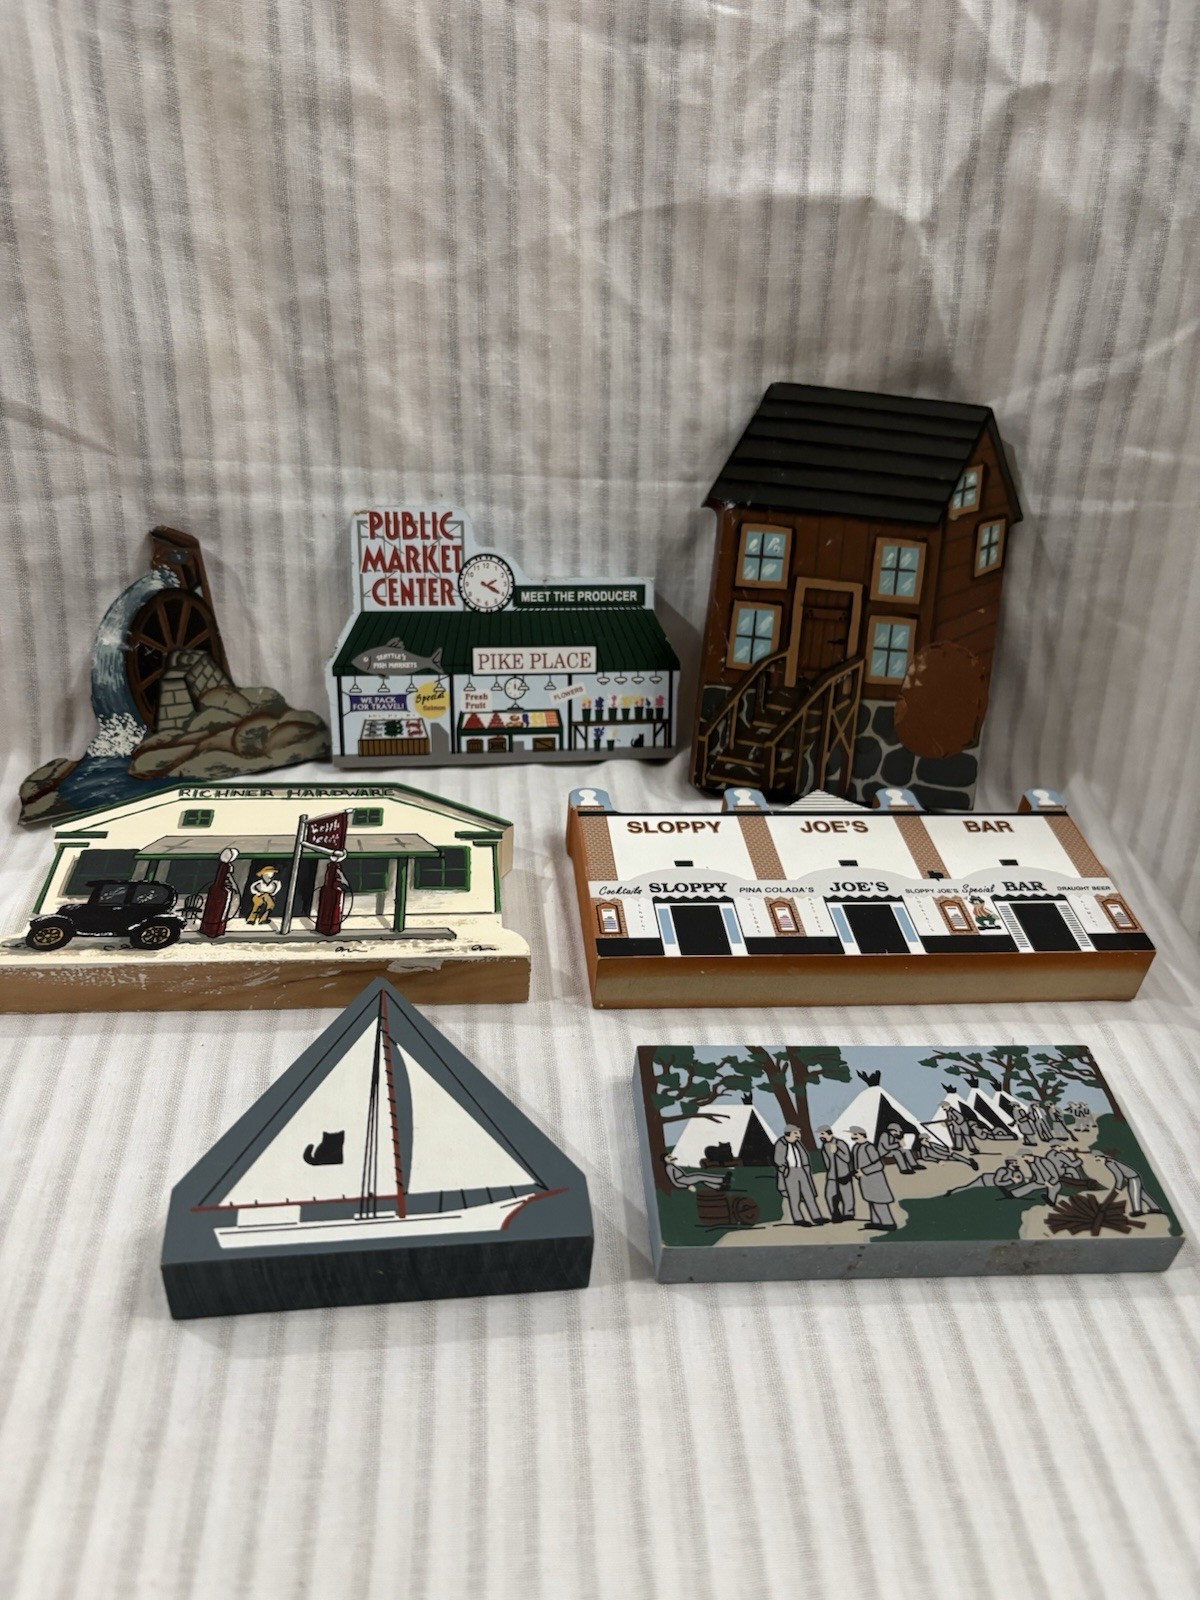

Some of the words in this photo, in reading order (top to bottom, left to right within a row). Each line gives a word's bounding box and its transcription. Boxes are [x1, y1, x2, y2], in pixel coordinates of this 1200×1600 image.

[368, 511, 453, 541] PUBLIC
[361, 544, 462, 573] MARKET
[371, 577, 456, 607] CENTER
[521, 591, 551, 602] MEET
[553, 591, 575, 602] THE
[577, 590, 638, 602] PRODUCER
[373, 662, 388, 670] FISH
[388, 661, 418, 669] MARKETS
[478, 653, 524, 670] PIKE
[529, 652, 592, 669] PLACE
[415, 690, 445, 704] Special
[465, 693, 488, 701] Fresh
[553, 685, 584, 701] FLOWERS
[376, 696, 396, 704] PACK
[465, 702, 487, 710] Fruit
[178, 788, 274, 798] RICHNER
[287, 788, 396, 798] HARDWARE
[627, 820, 721, 834] SLOPPY
[800, 820, 869, 833] JOE'S
[962, 820, 1015, 833] BAR
[598, 885, 643, 896] Cocktails
[649, 882, 728, 893] SLOPPY
[829, 881, 889, 892] JOE'S
[1001, 881, 1047, 892] BAR
[962, 883, 995, 895] Special
